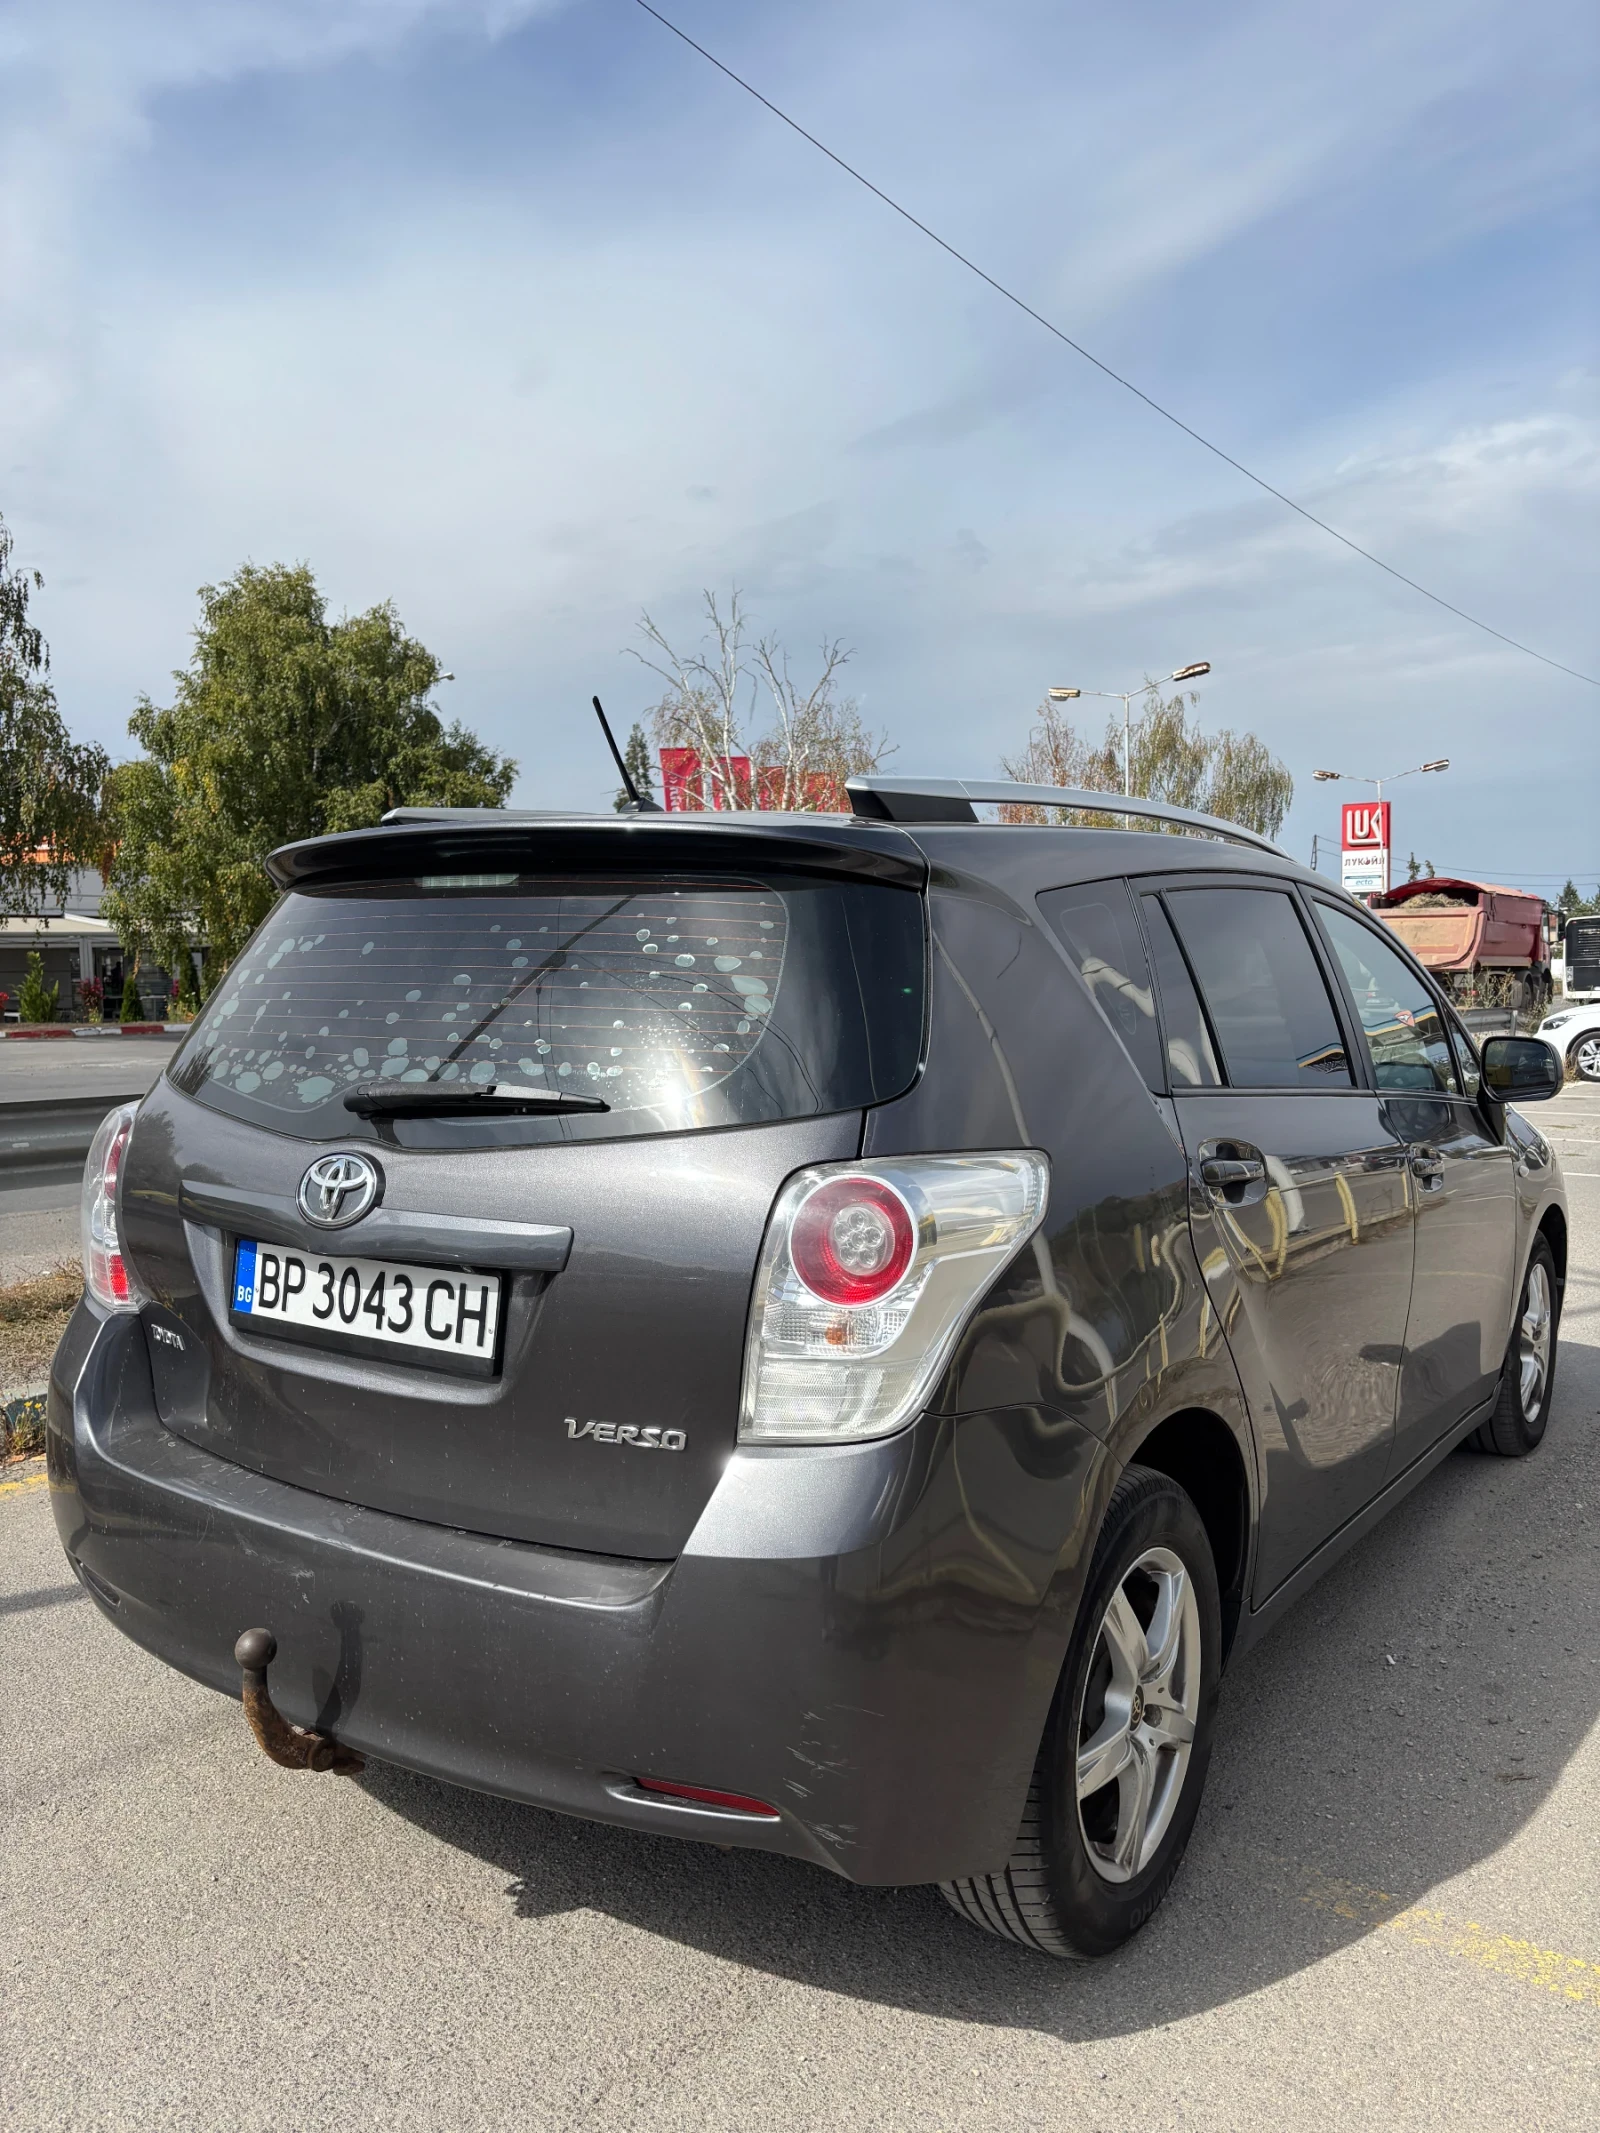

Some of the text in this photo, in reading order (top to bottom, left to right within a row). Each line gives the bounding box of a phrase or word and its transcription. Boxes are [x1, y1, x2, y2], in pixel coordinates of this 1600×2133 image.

[1355, 878, 1373, 886] ecto
[237, 1285, 252, 1303] BG
[258, 1253, 489, 1347] BP 3043 CH
[564, 1417, 687, 1451] VERSO
